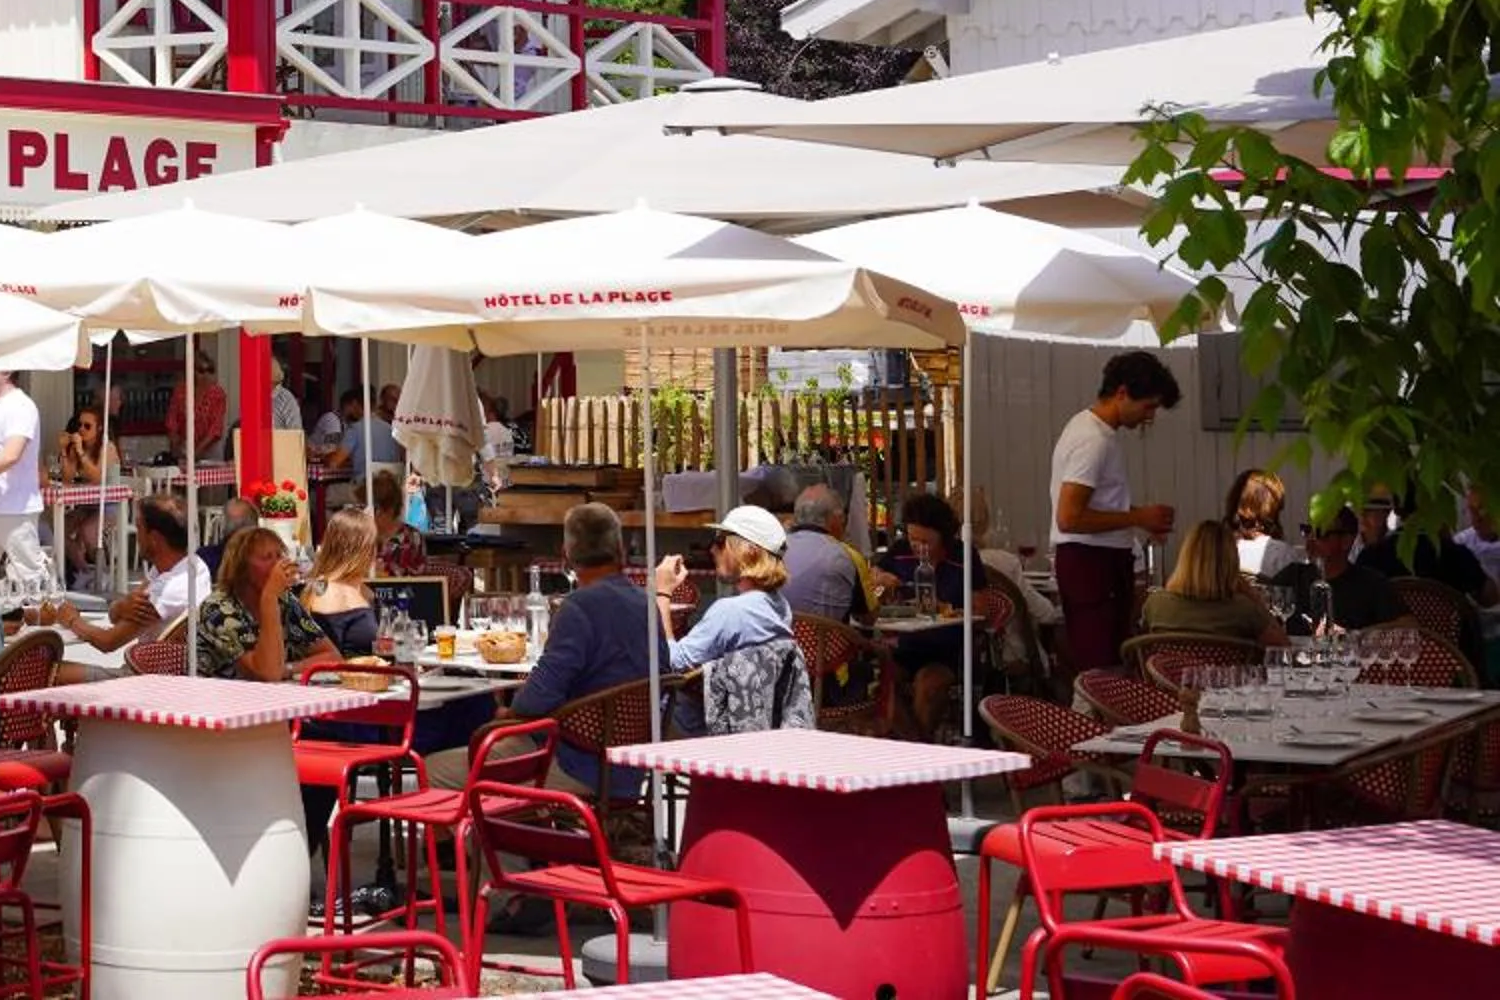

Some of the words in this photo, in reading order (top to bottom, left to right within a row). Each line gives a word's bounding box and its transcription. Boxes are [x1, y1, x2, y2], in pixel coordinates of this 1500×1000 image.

[8, 129, 218, 192] PLAGE
[484, 292, 546, 308] HÔTEL
[549, 293, 574, 305] DE
[579, 292, 604, 304] LA
[608, 290, 673, 304] PLAGE
